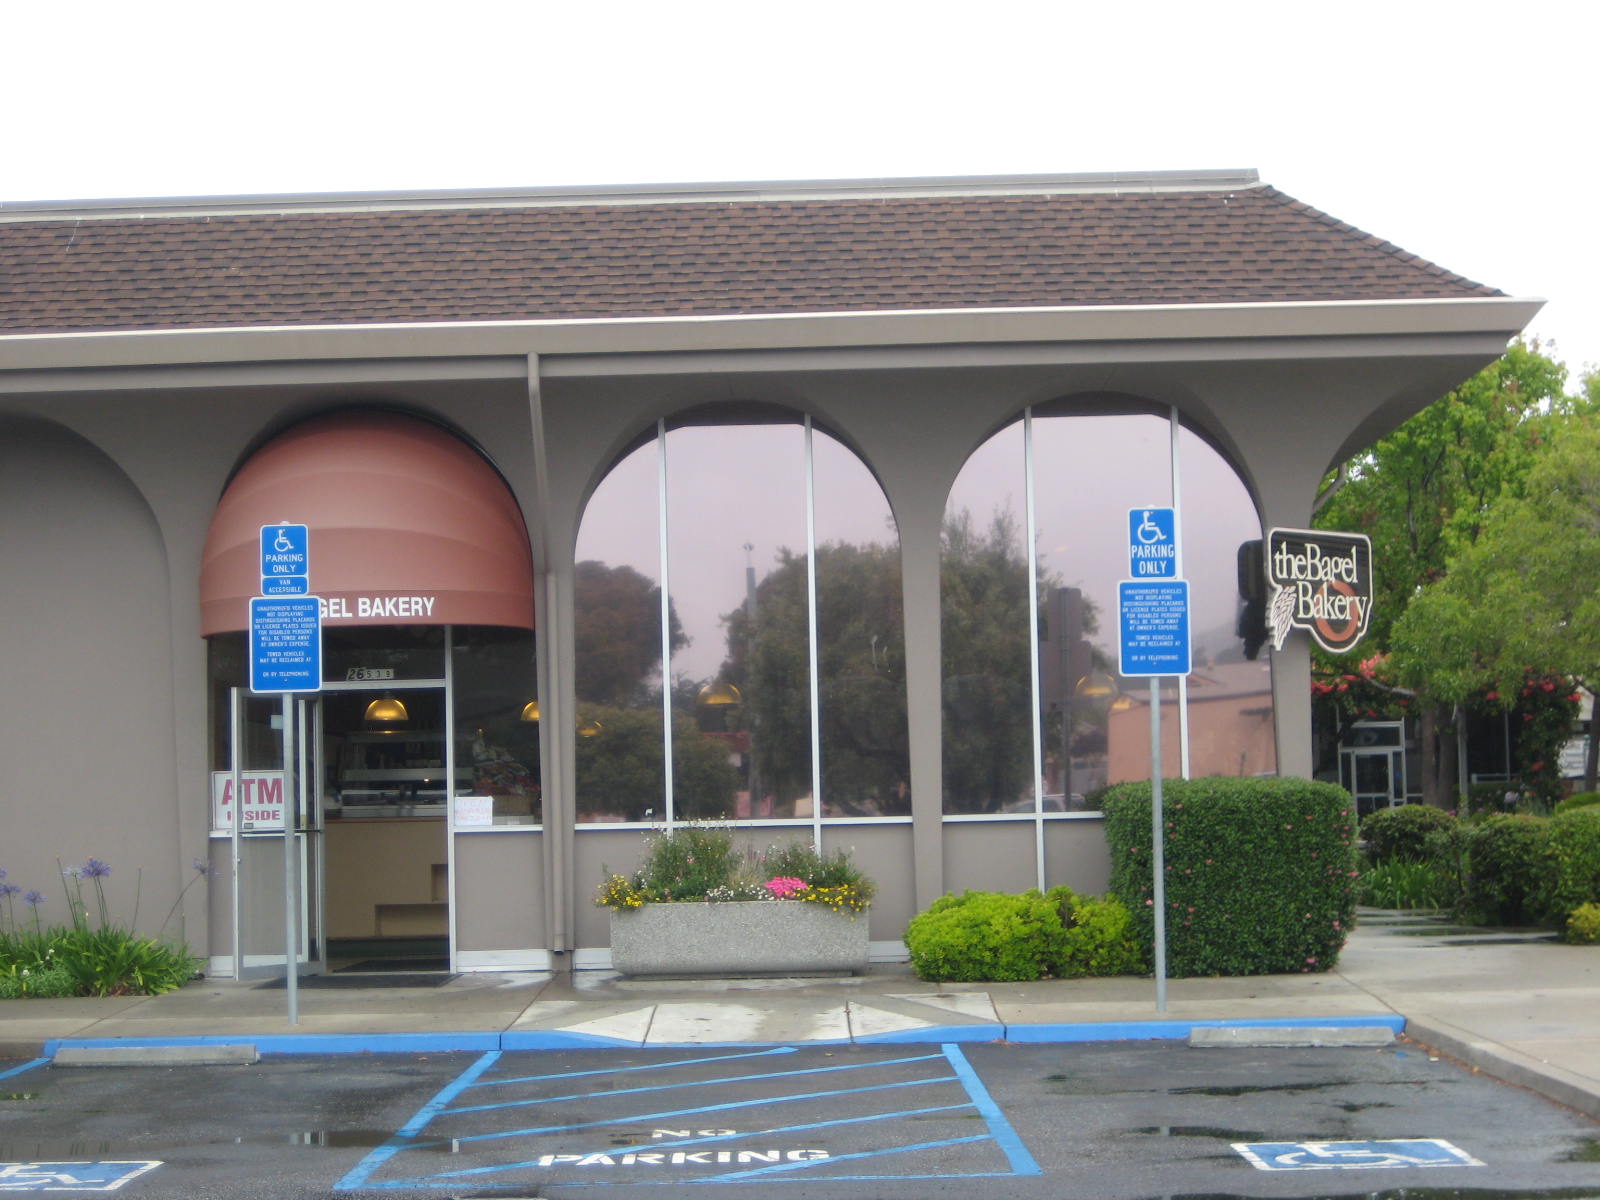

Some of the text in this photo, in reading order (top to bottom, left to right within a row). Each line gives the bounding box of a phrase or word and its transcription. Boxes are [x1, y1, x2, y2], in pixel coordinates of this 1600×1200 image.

[265, 554, 303, 562] PARKING
[1131, 544, 1174, 558] PARKING
[272, 564, 296, 572] ONLY
[1139, 560, 1167, 574] ONLY
[358, 597, 435, 616] BAKERY
[1296, 581, 1368, 627] Bakery
[227, 810, 280, 821] ISIDE
[652, 1129, 736, 1138] NO
[538, 1150, 830, 1166] PARKING
